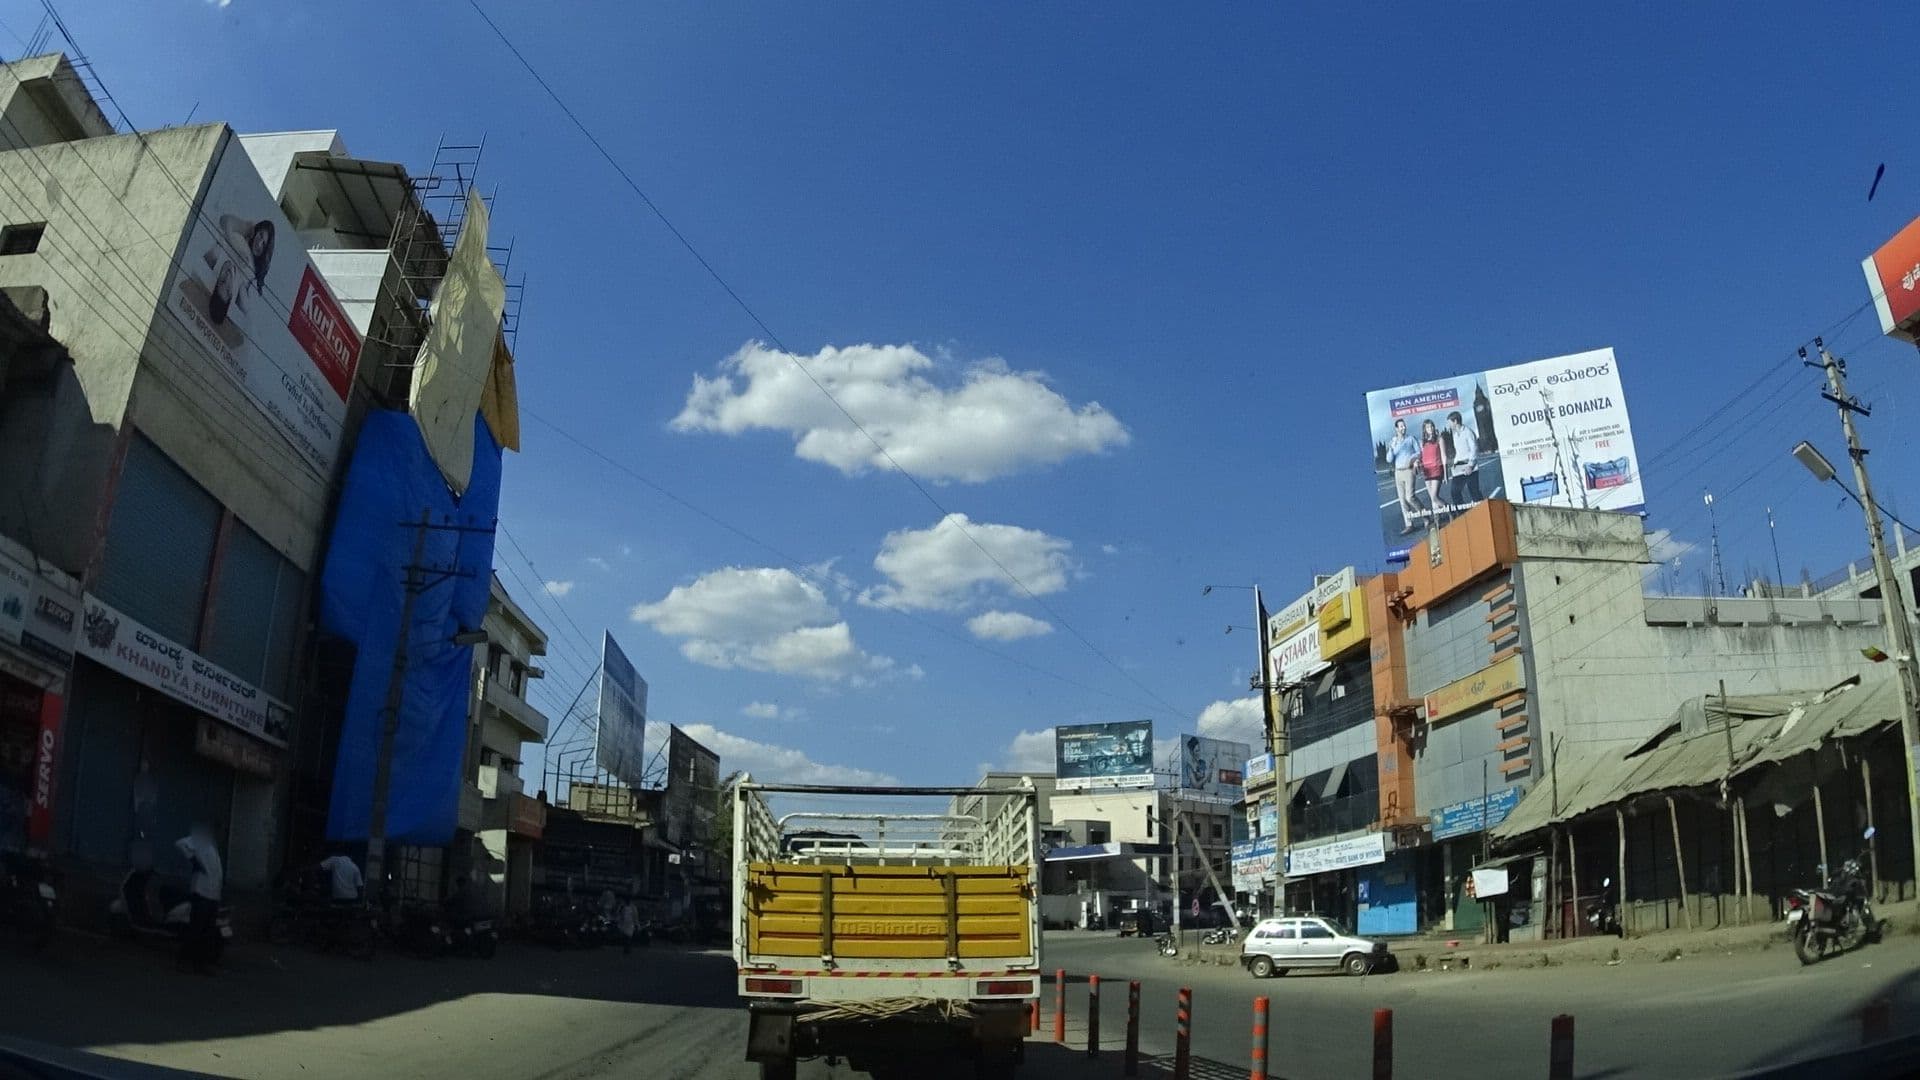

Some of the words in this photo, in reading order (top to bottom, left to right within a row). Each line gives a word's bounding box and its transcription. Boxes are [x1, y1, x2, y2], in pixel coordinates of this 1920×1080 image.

[1395, 400, 1412, 408] PAN
[1414, 391, 1452, 405] AMERICA
[1558, 397, 1613, 418] BONANZA
[1595, 440, 1611, 448] FREE
[1527, 452, 1544, 461] FREE
[1284, 638, 1307, 665] STAAR
[116, 643, 190, 689] KHANDYA
[194, 683, 265, 728] FURNITURE
[36, 729, 55, 809] SERVO
